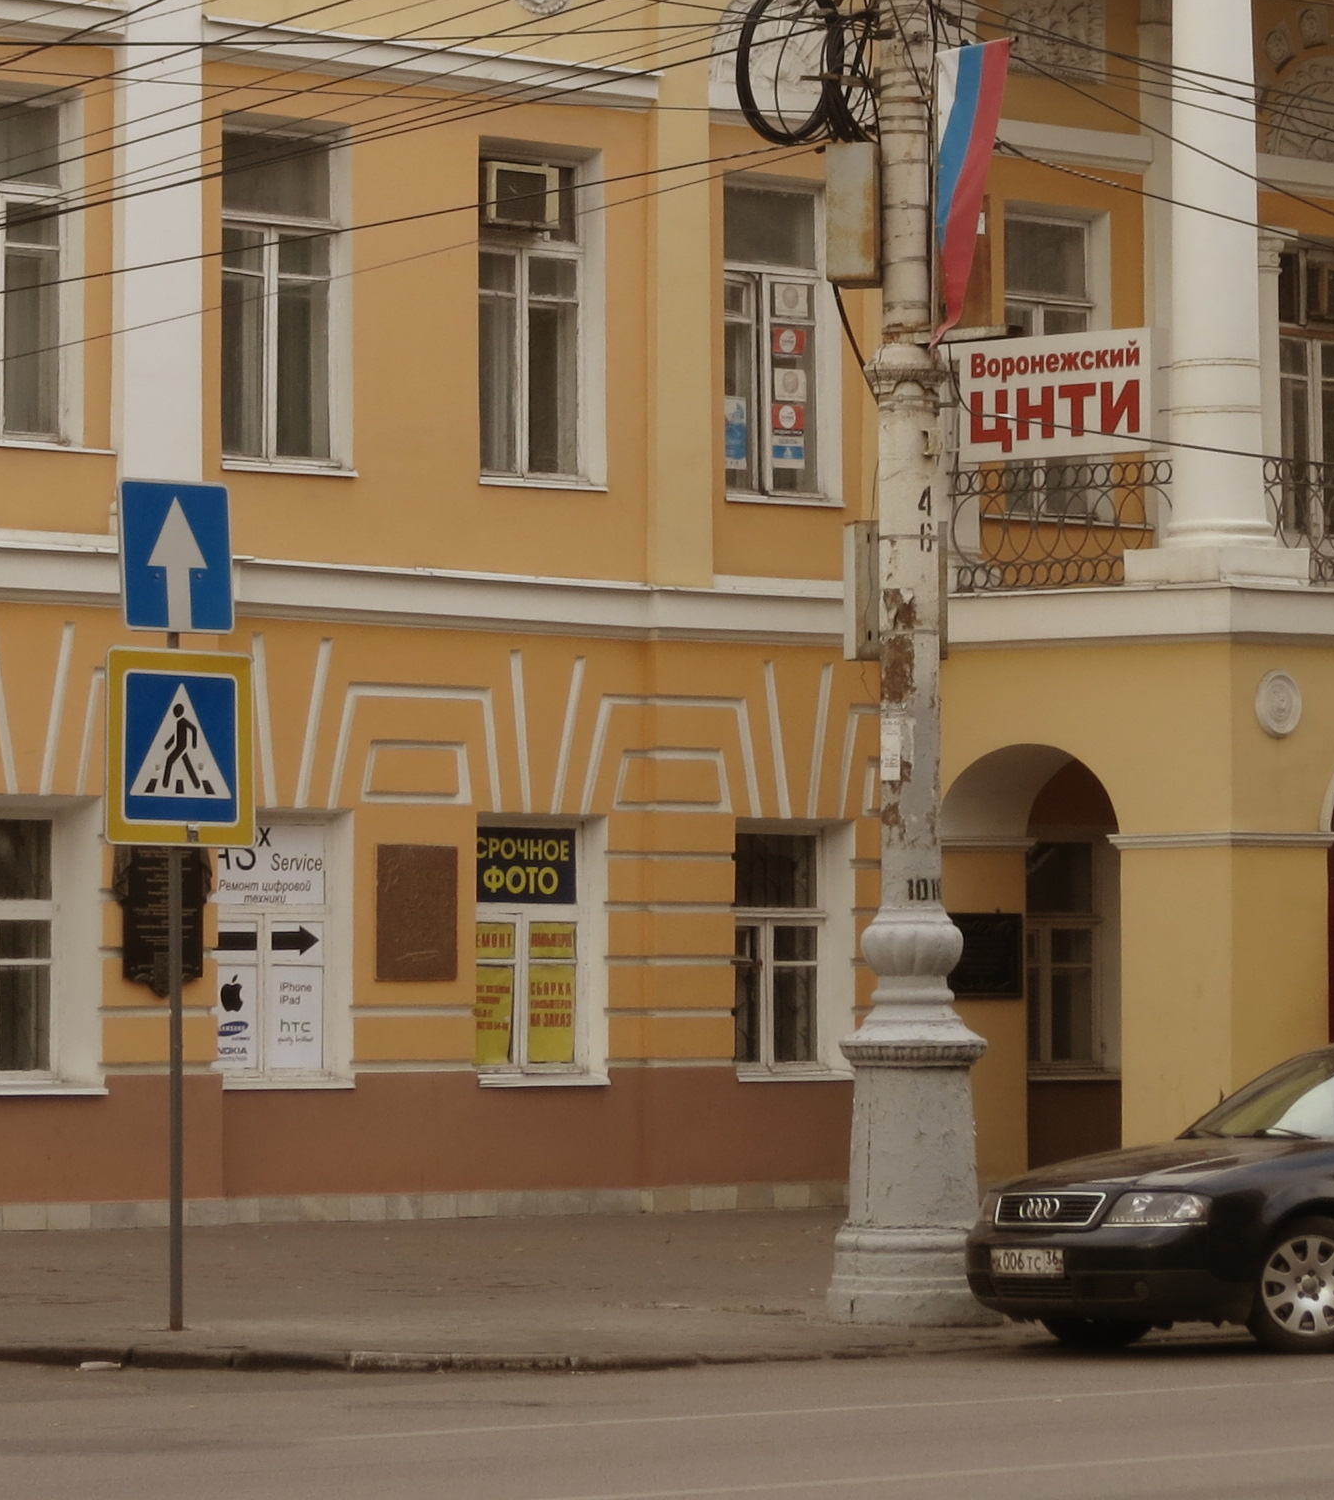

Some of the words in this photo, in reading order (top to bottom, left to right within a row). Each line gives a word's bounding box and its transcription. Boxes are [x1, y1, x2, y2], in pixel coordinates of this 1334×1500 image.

[970, 340, 1140, 383] Воронежский
[970, 379, 1140, 453] ЦНТИ
[476, 837, 569, 862] СРОЧНОЕ
[270, 852, 323, 872] Service
[218, 879, 259, 892] Ремонт
[261, 879, 312, 894] цифровой
[483, 865, 559, 895] ФОТО
[243, 894, 287, 904] техники
[279, 982, 312, 993] iPhone
[531, 982, 573, 996] СБОРКА
[279, 995, 301, 1005] iPad
[530, 1013, 542, 1028] НА
[543, 1013, 572, 1028] ЗАКАЗ
[1045, 1250, 1060, 1265] 36
